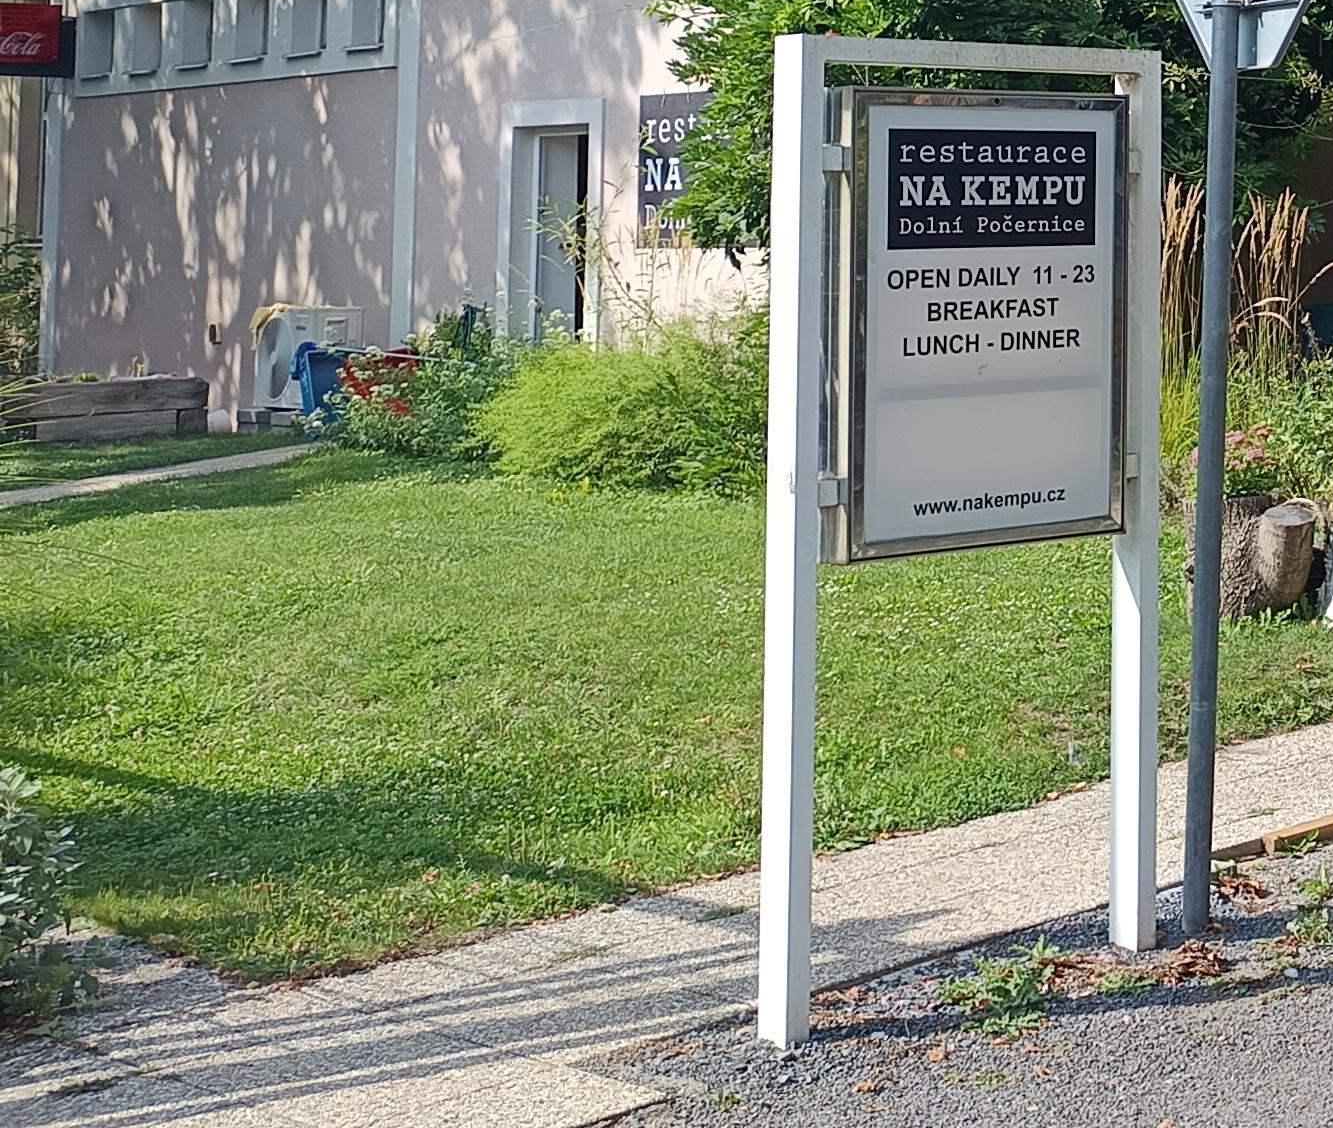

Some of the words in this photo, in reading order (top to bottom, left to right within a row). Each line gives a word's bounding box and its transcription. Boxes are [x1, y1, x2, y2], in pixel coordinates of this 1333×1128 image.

[899, 141, 1087, 164] restaurace
[644, 157, 683, 192] NA
[899, 175, 950, 206] NA
[961, 175, 1086, 206] KEMPU
[899, 216, 963, 235] Dolní
[977, 214, 1085, 234] Počernice
[887, 268, 950, 290] OPEN
[959, 266, 1021, 288] DAILY
[1033, 265, 1053, 285] 11
[1072, 264, 1096, 284] 23
[927, 297, 1060, 321] BREAKFAST
[902, 333, 981, 356] LUNCH
[1000, 329, 1081, 352] DINNER
[913, 487, 1066, 517] www.nakempu.cz
